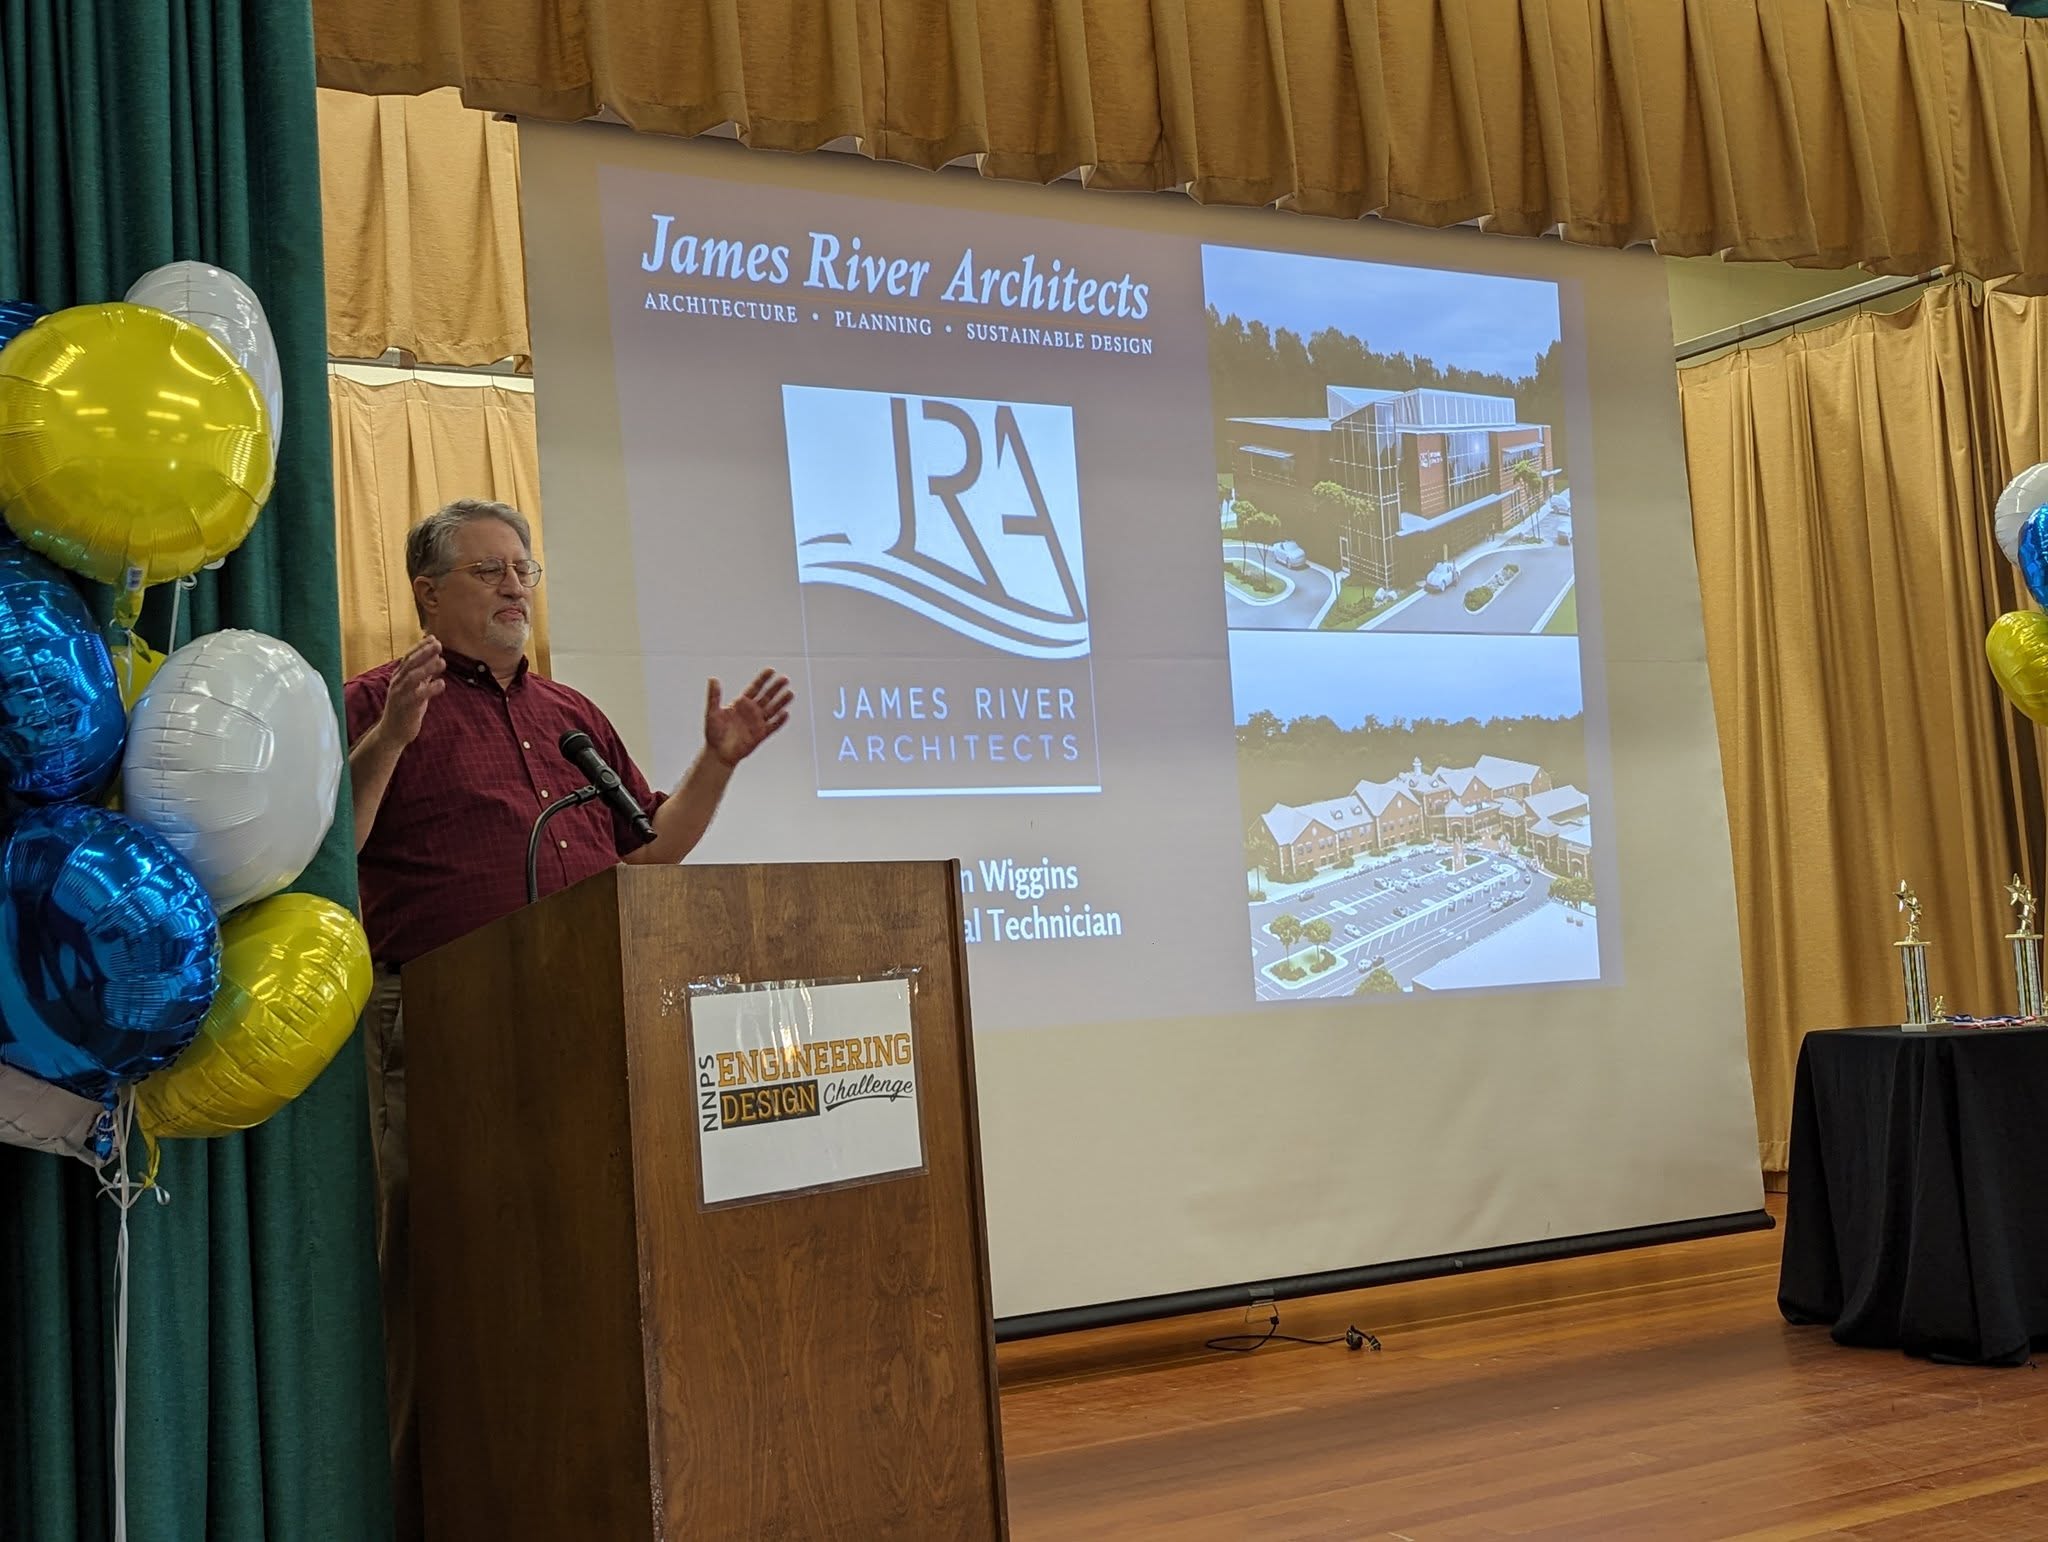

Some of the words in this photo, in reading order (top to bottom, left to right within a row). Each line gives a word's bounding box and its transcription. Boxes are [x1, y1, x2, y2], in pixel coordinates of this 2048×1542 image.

[641, 213, 790, 284] James
[803, 231, 930, 298] River
[941, 248, 1150, 321] Architects
[644, 292, 798, 323] ARCHITECTURE
[834, 311, 932, 336] PLANNING
[966, 323, 1085, 350] SUSTAINABLE
[1091, 333, 1153, 355] DESIGN
[833, 686, 948, 720] JAMES
[975, 687, 1077, 720] RIVER
[838, 735, 1079, 763] ARCHITECTS
[979, 857, 1079, 900] Wiggins
[986, 904, 1122, 942] Technician
[717, 1033, 912, 1087] ENGINEERING
[699, 1054, 719, 1132] NNPS
[721, 1083, 818, 1125] DESIGN
[823, 1073, 914, 1105] Challenge
